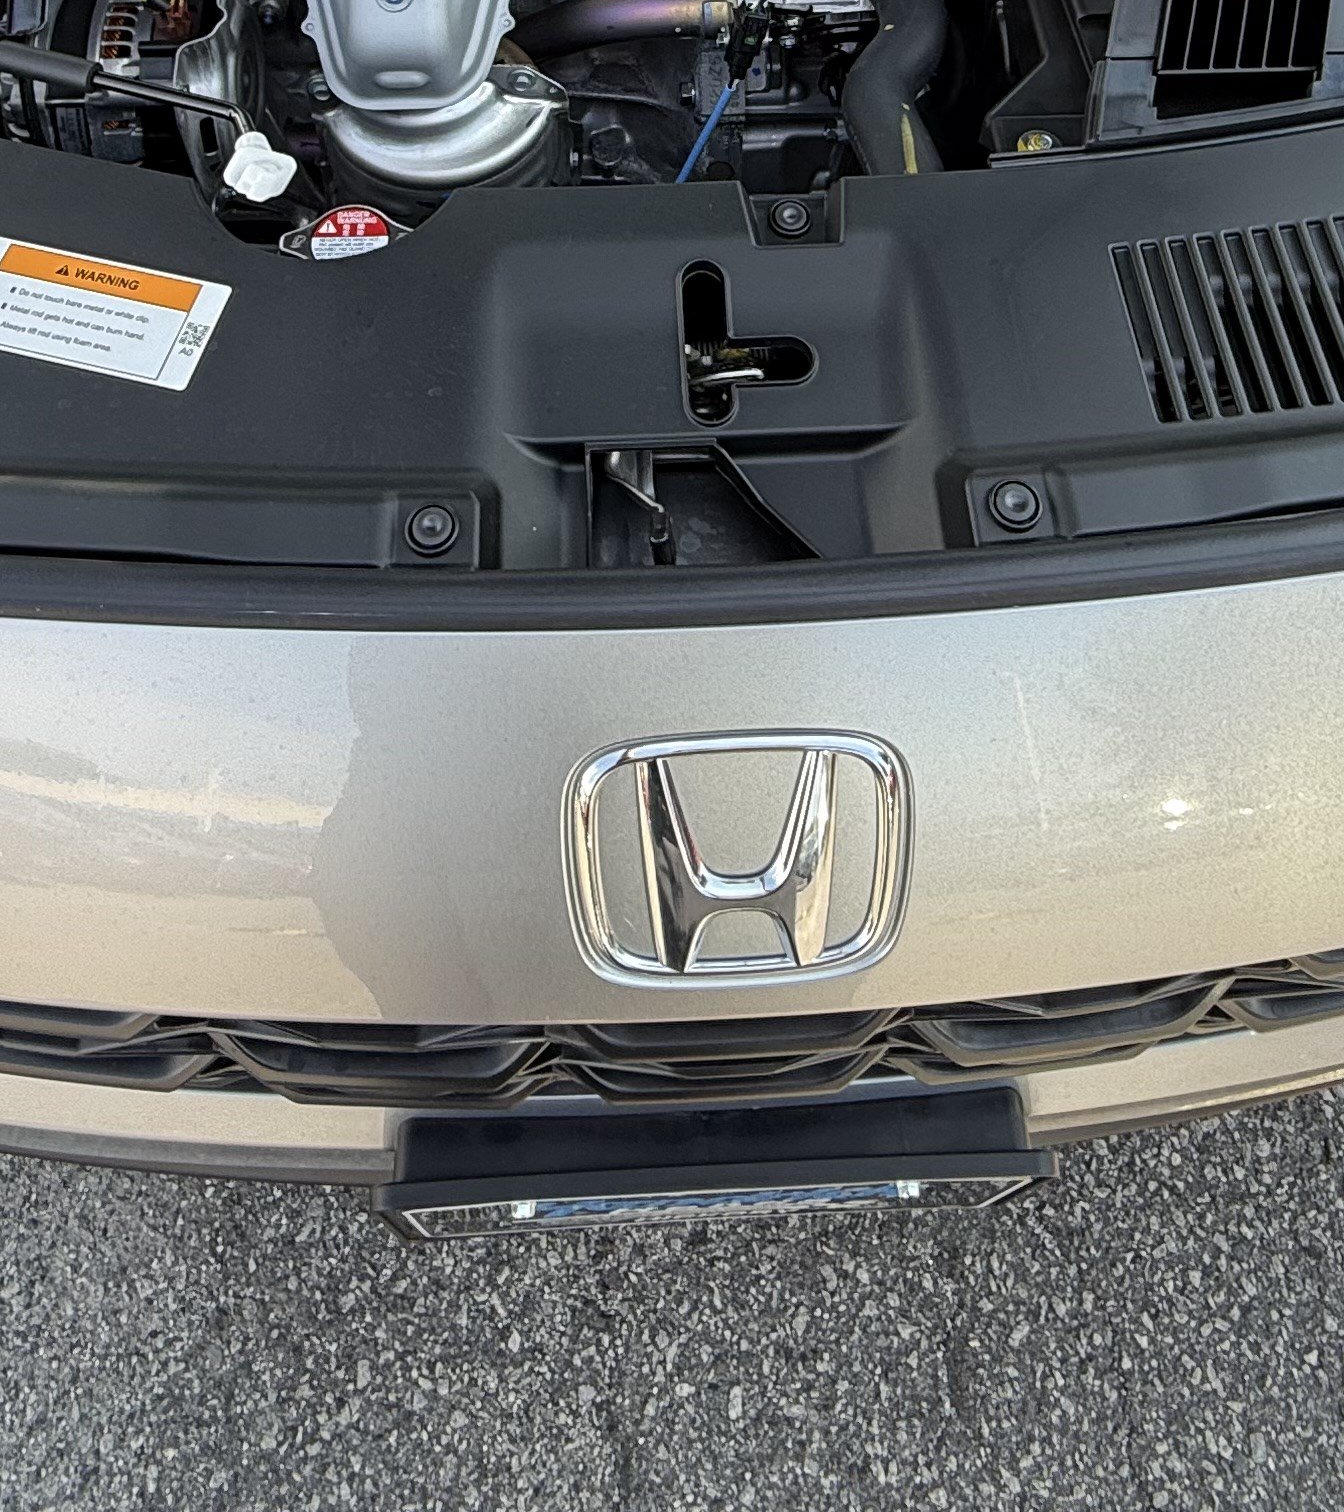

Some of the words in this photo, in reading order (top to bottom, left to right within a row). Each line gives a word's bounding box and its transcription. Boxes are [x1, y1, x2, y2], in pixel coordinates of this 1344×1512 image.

[75, 268, 140, 291] WARNING
[19, 288, 30, 297] Do
[44, 295, 64, 304] touch
[65, 299, 82, 308] bare
[83, 304, 105, 313] metal
[0, 321, 26, 333] Always
[10, 305, 30, 315] Metal
[75, 320, 90, 329] and
[91, 324, 105, 332] can
